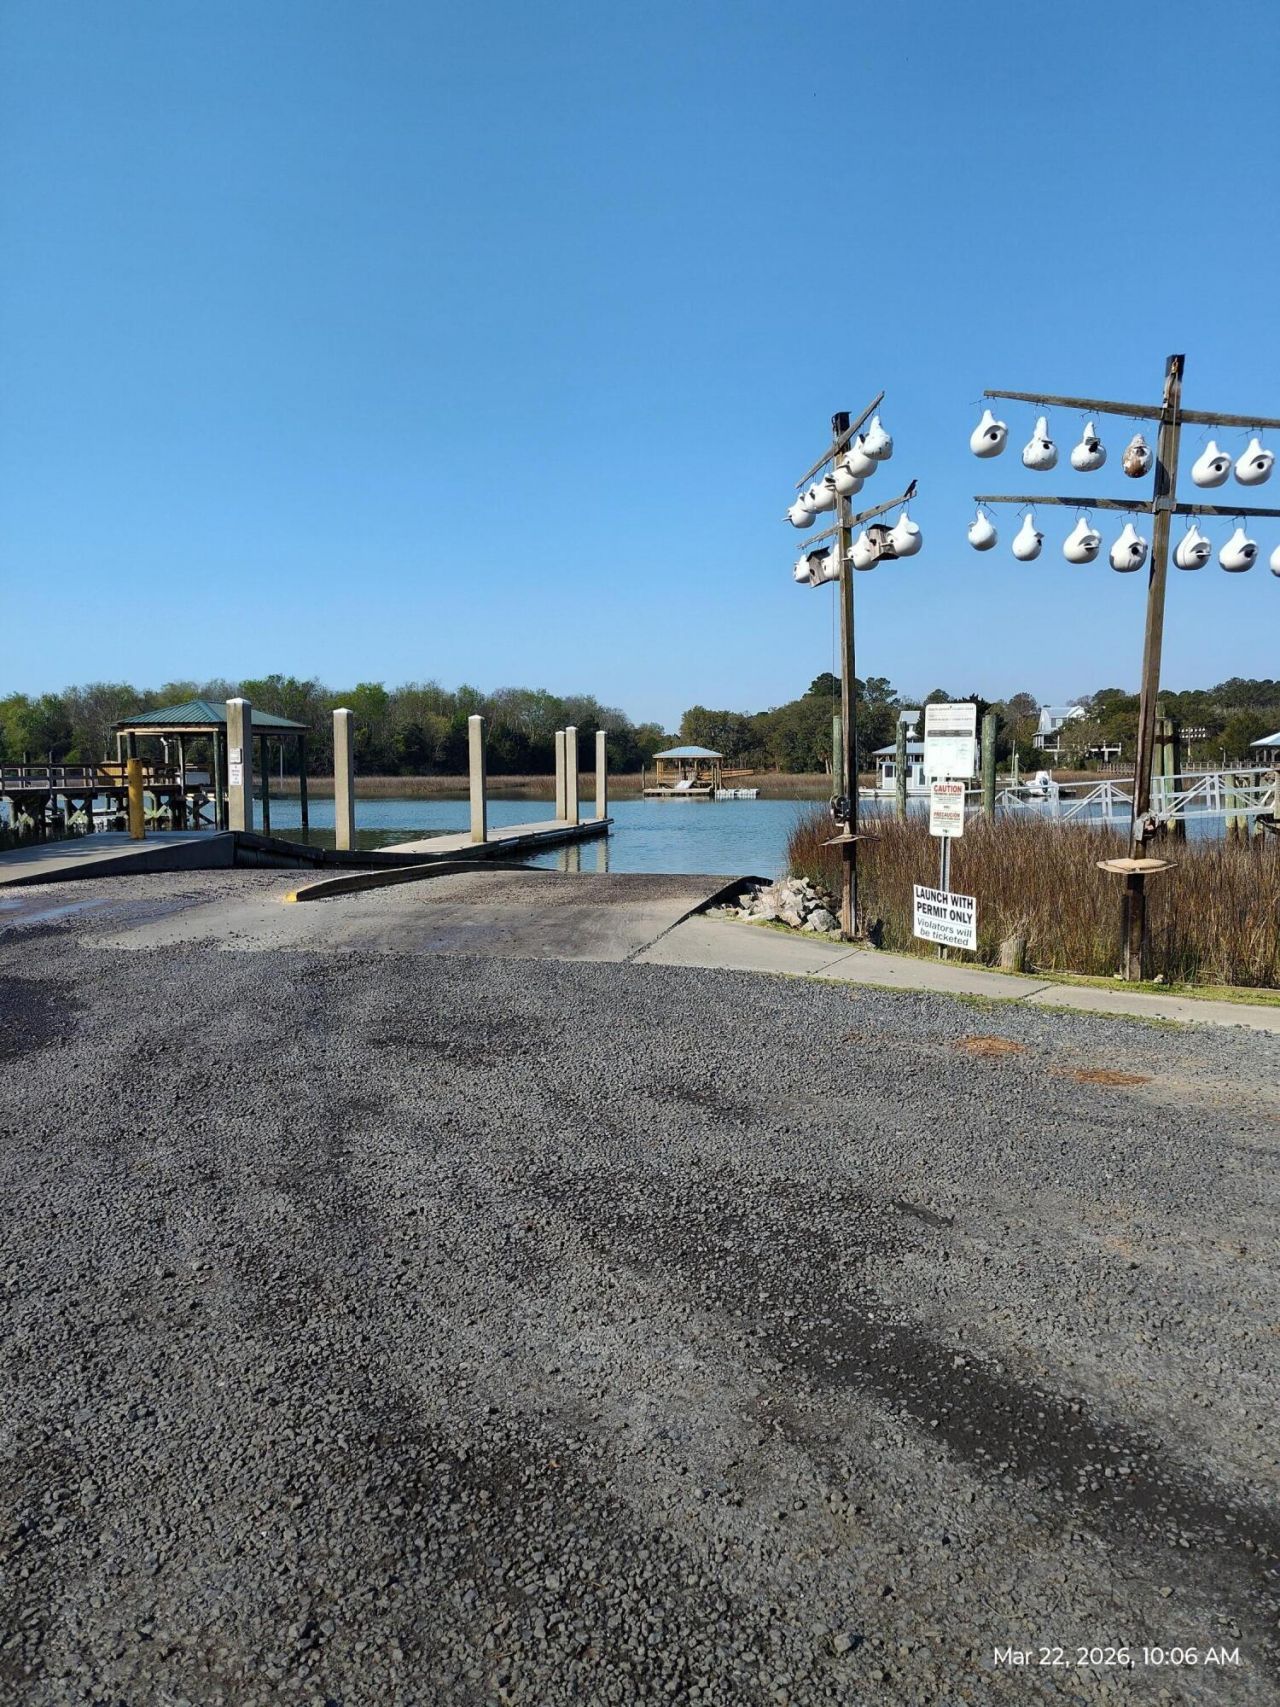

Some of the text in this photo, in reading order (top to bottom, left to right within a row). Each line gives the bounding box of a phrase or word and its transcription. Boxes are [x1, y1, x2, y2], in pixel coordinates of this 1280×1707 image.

[933, 784, 962, 793] CAUTION
[915, 886, 974, 910] LAUNCH WITH
[916, 901, 973, 925] PERMIT ONLY
[917, 917, 972, 938] Violators will
[920, 927, 969, 946] be ticketed
